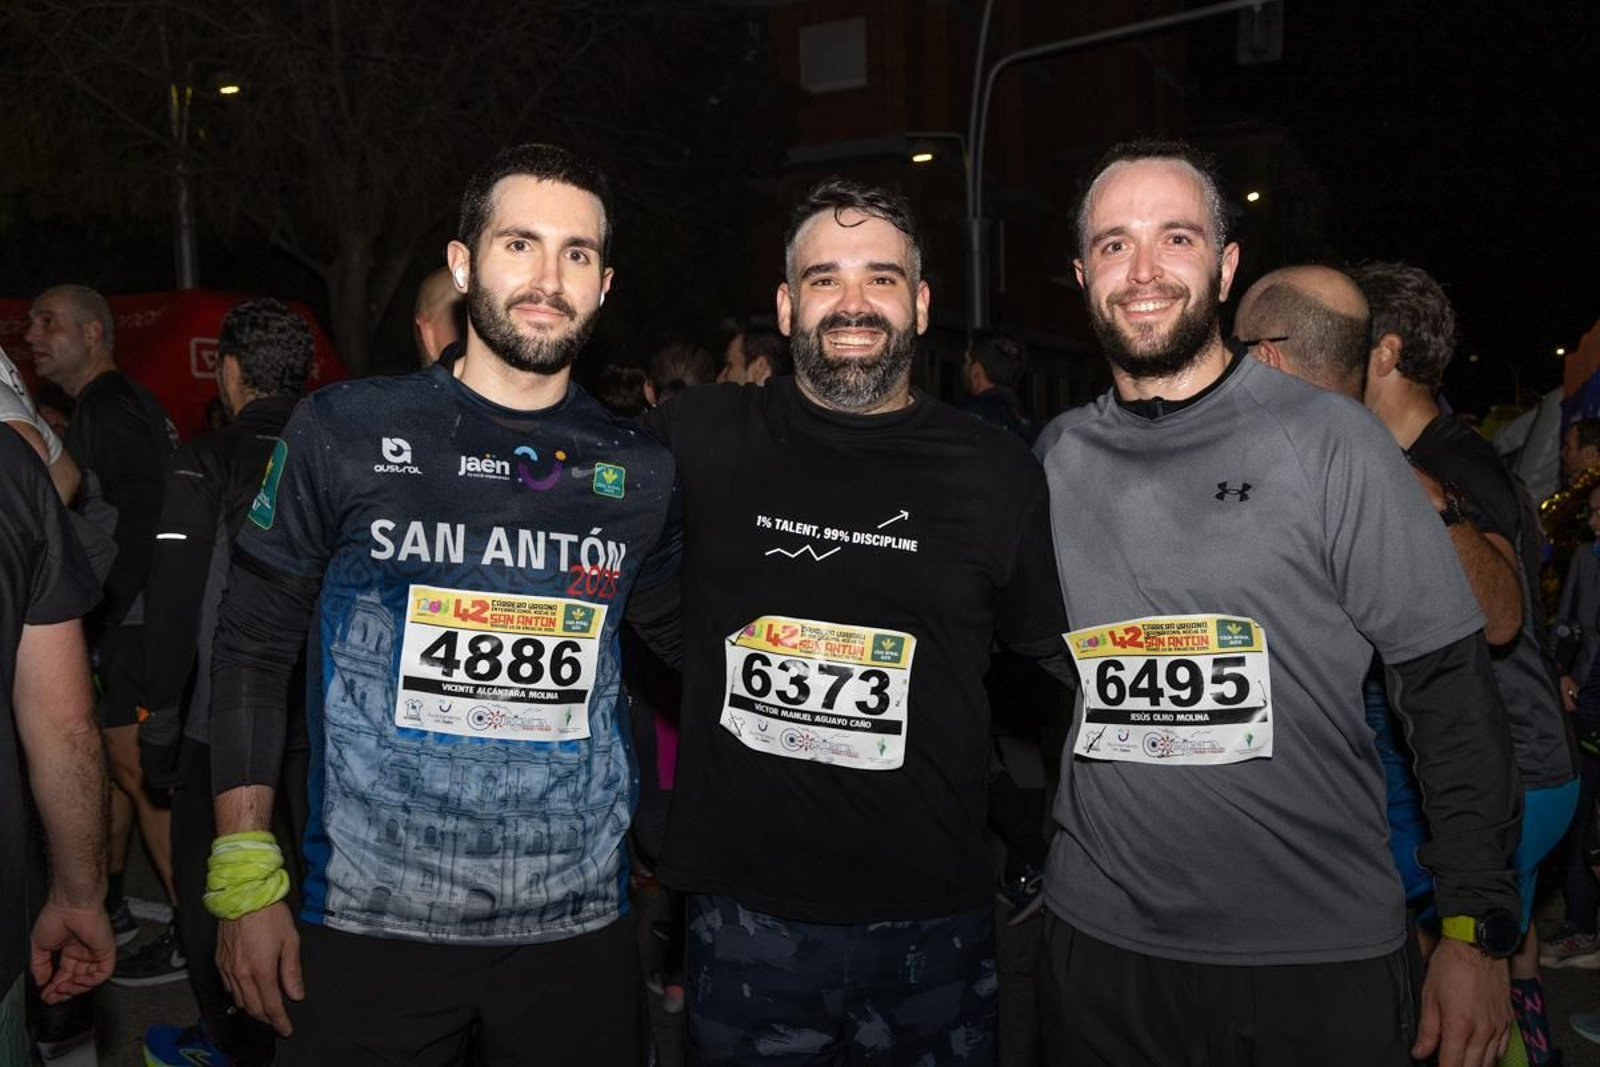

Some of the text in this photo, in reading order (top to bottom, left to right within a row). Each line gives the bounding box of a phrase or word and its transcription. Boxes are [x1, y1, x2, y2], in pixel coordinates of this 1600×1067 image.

[756, 515, 918, 552] 1% TALENT, 99% DISCIPLINE
[370, 519, 627, 579] SAN ANTÓN
[454, 598, 490, 624] 42
[490, 613, 514, 624] SAN
[766, 622, 800, 649] 42
[1109, 625, 1145, 649] 42
[1144, 636, 1166, 648] SAN
[419, 630, 582, 687] 4886
[442, 683, 474, 694] VICENTE
[529, 691, 559, 700] MOLINA
[742, 652, 890, 716] 6373
[1096, 656, 1251, 707] 6495
[754, 703, 872, 729] VÍCTOR MANUEL AGUAYO CAÑO
[1130, 711, 1151, 721] JESÚS
[1176, 713, 1210, 722] MOLINA
